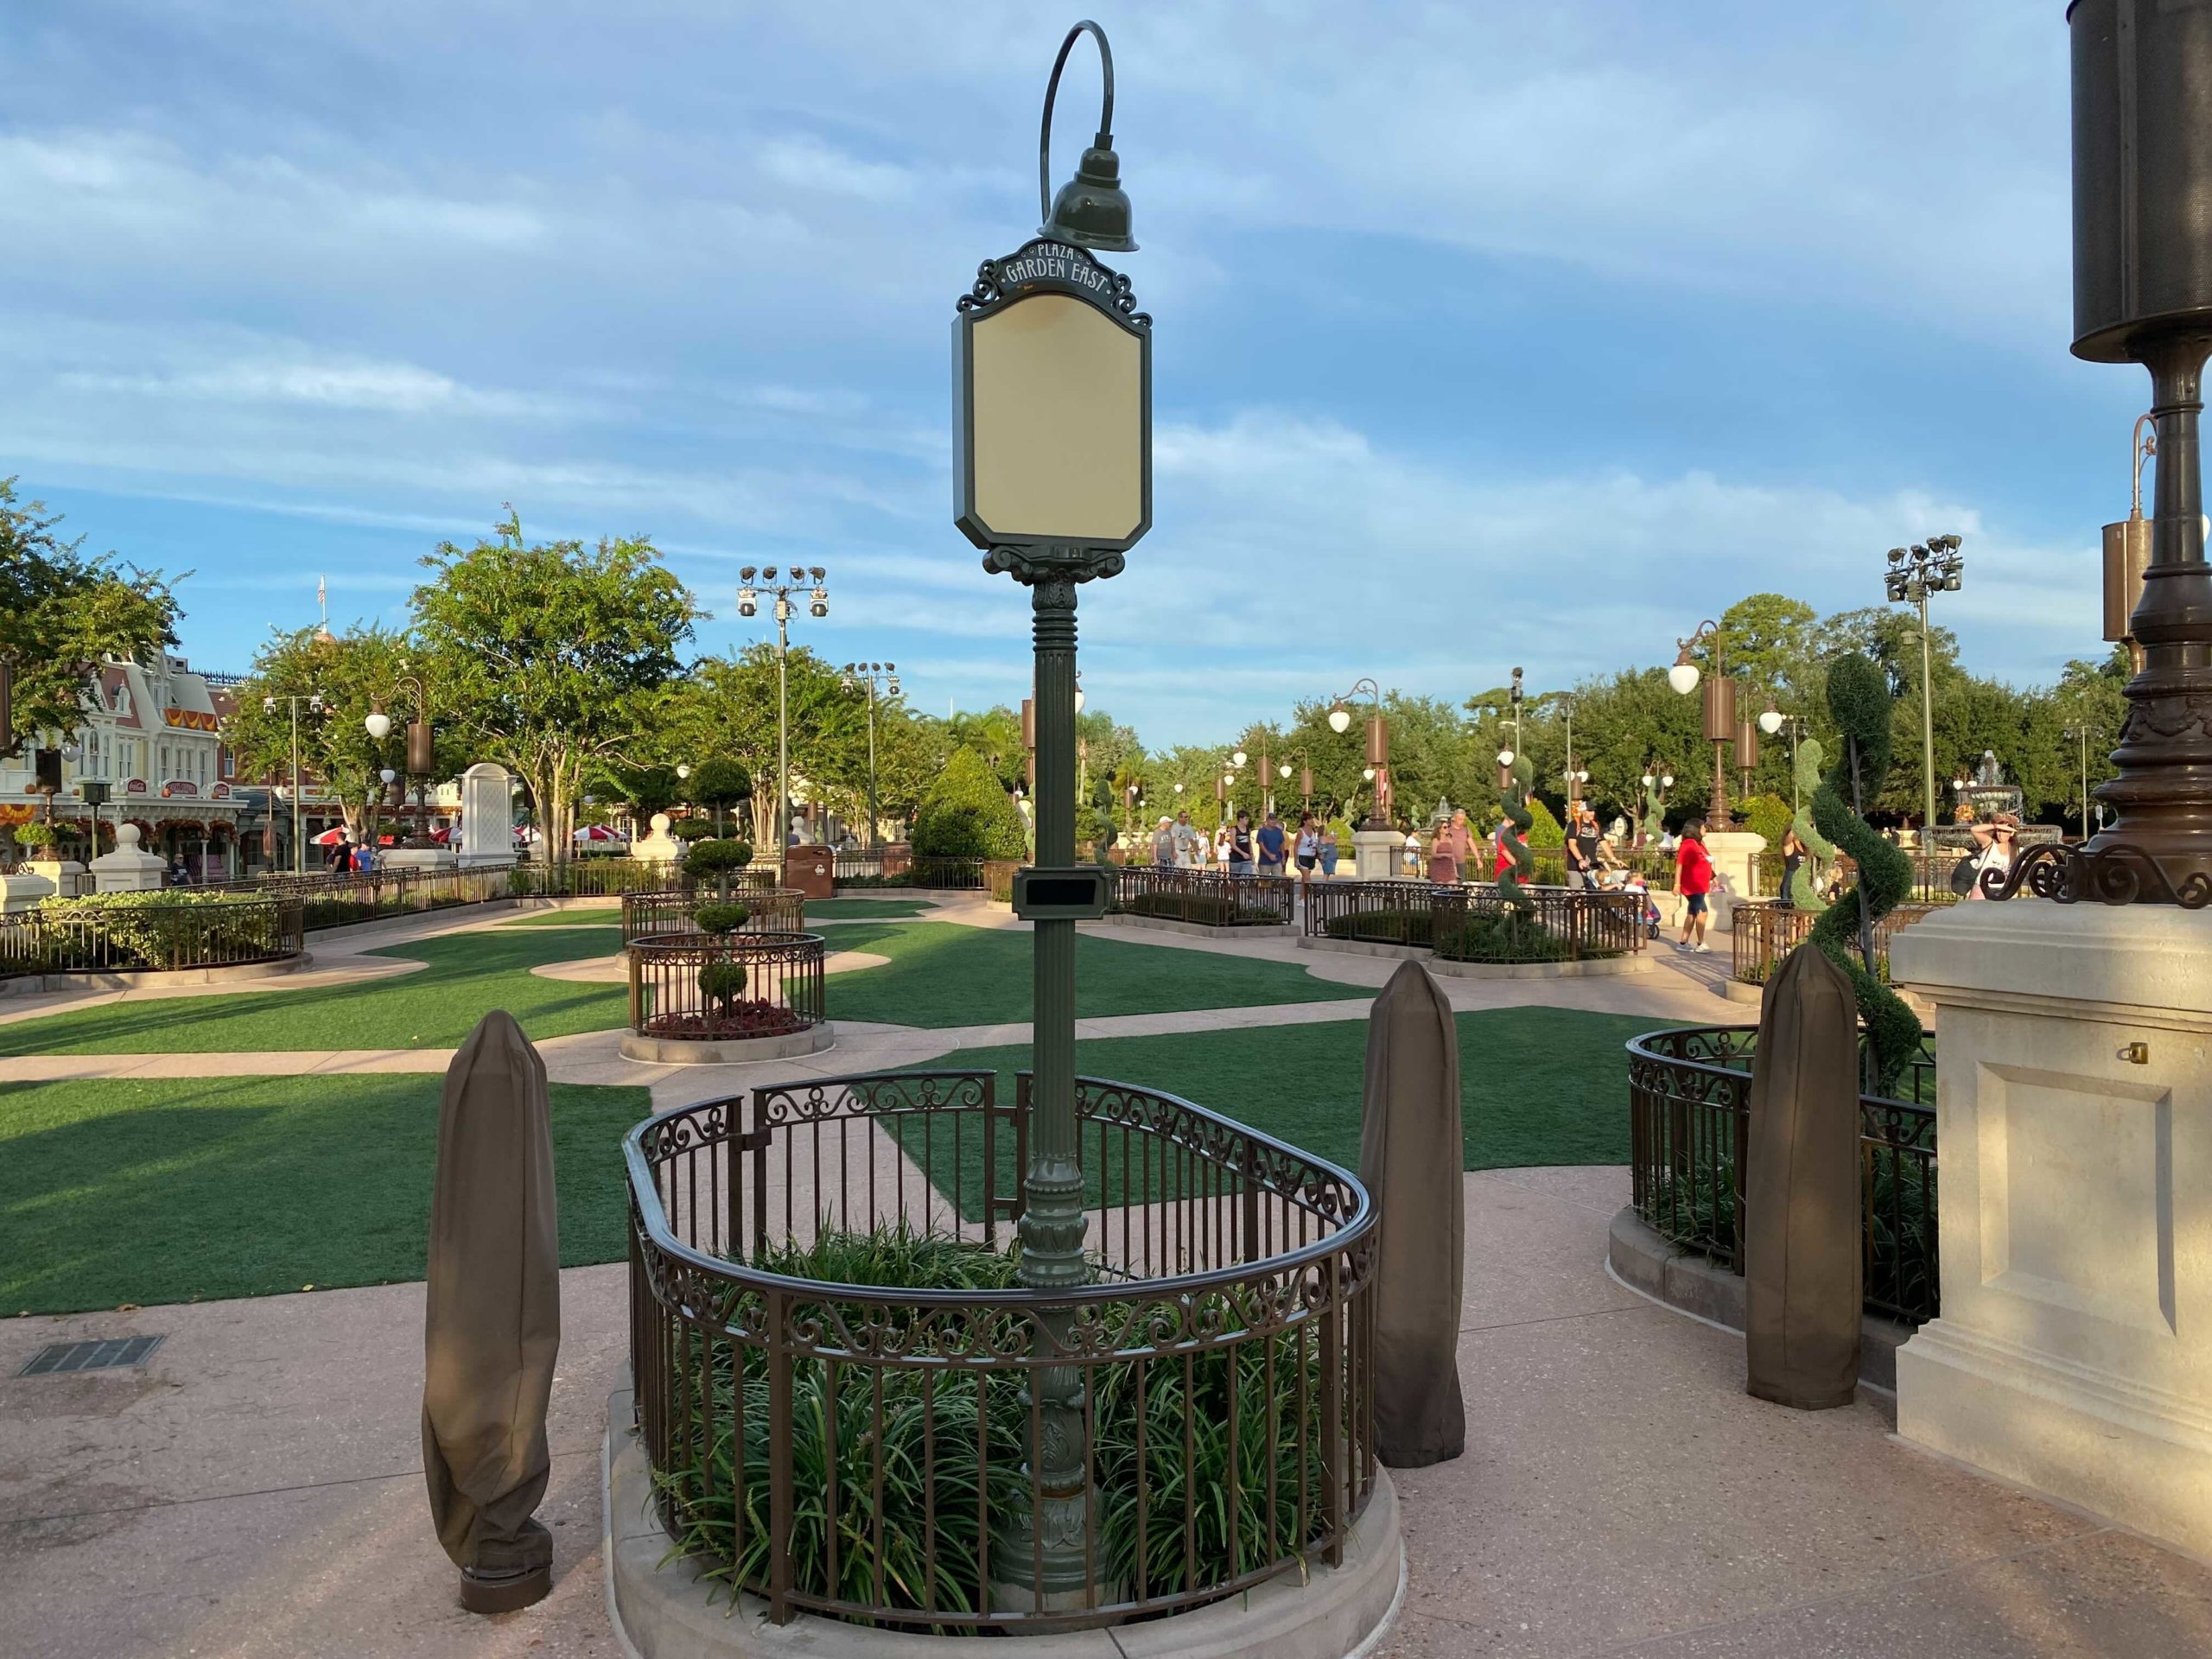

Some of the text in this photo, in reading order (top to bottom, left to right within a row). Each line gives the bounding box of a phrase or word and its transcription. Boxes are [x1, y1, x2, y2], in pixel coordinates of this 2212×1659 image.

[1037, 244, 1074, 260] PLAZA
[1005, 258, 1109, 292] GARDEN EAST
